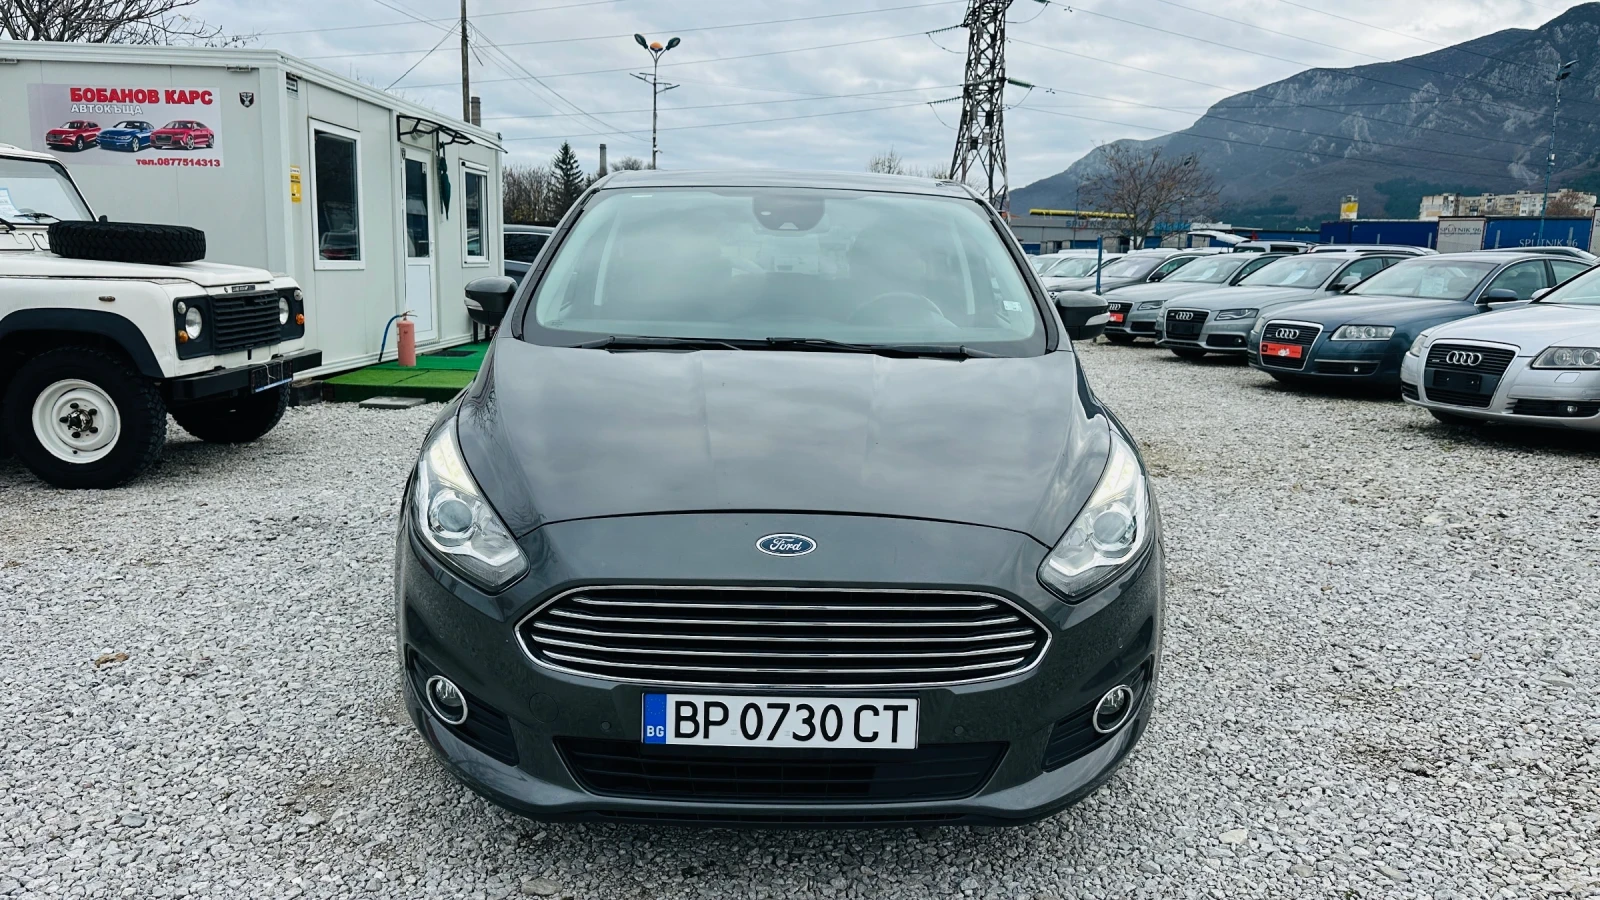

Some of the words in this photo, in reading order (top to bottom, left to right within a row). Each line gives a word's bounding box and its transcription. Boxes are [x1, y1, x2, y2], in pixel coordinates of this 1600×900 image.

[70, 87, 160, 104] БОБАНОВ
[165, 89, 213, 105] КАРС
[70, 104, 143, 116] АВТОКЪЩА
[769, 538, 803, 551] Ford
[674, 700, 729, 739] BP
[739, 702, 844, 742] 0730
[853, 704, 909, 743] CT
[646, 725, 665, 737] BG
